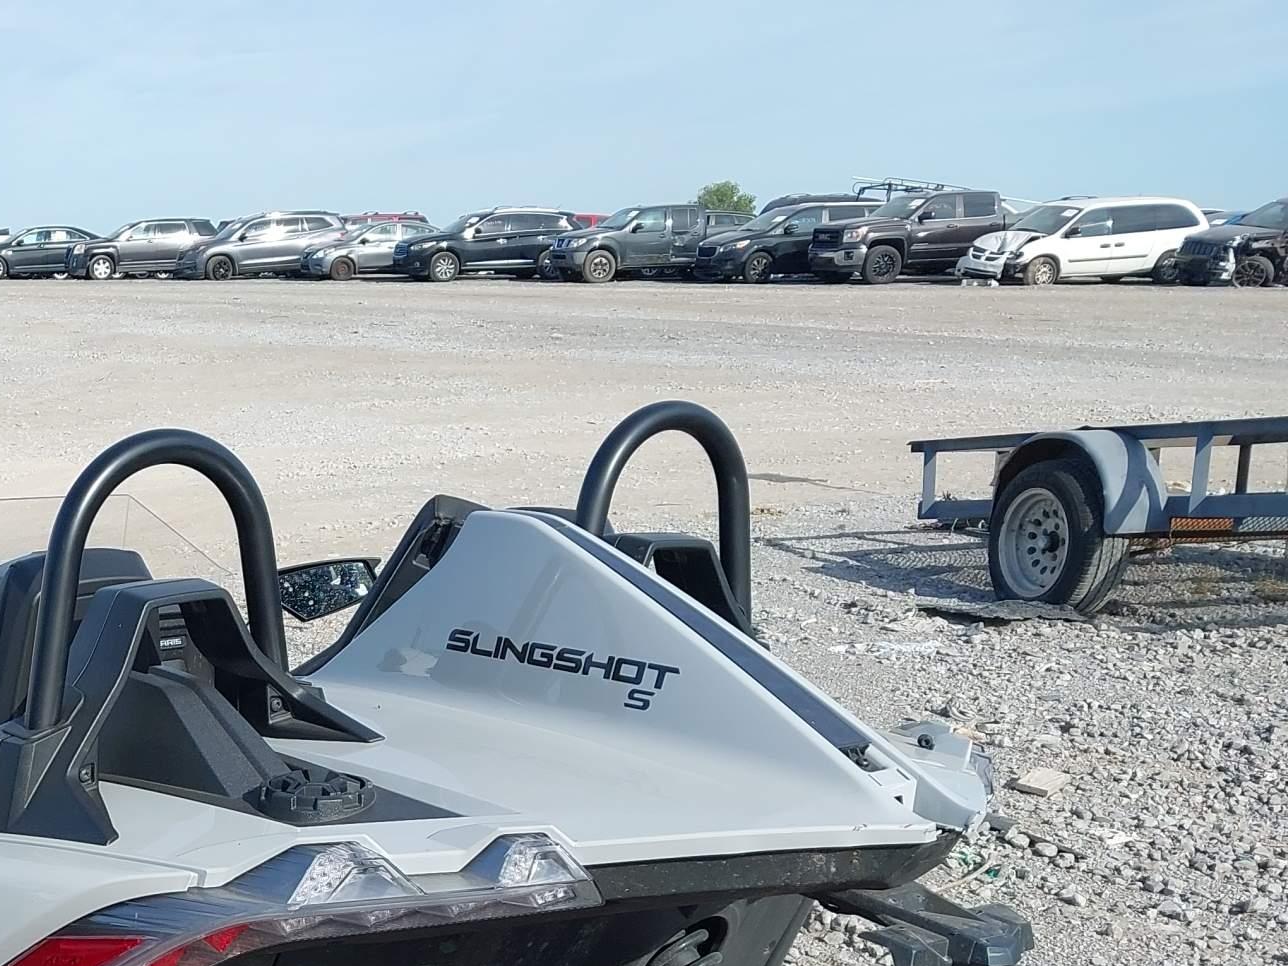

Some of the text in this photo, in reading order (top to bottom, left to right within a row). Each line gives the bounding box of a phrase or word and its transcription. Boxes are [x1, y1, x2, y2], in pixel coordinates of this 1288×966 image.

[159, 638, 182, 647] ARIS
[446, 628, 681, 690] SLINGSHOT
[623, 688, 656, 711] S
